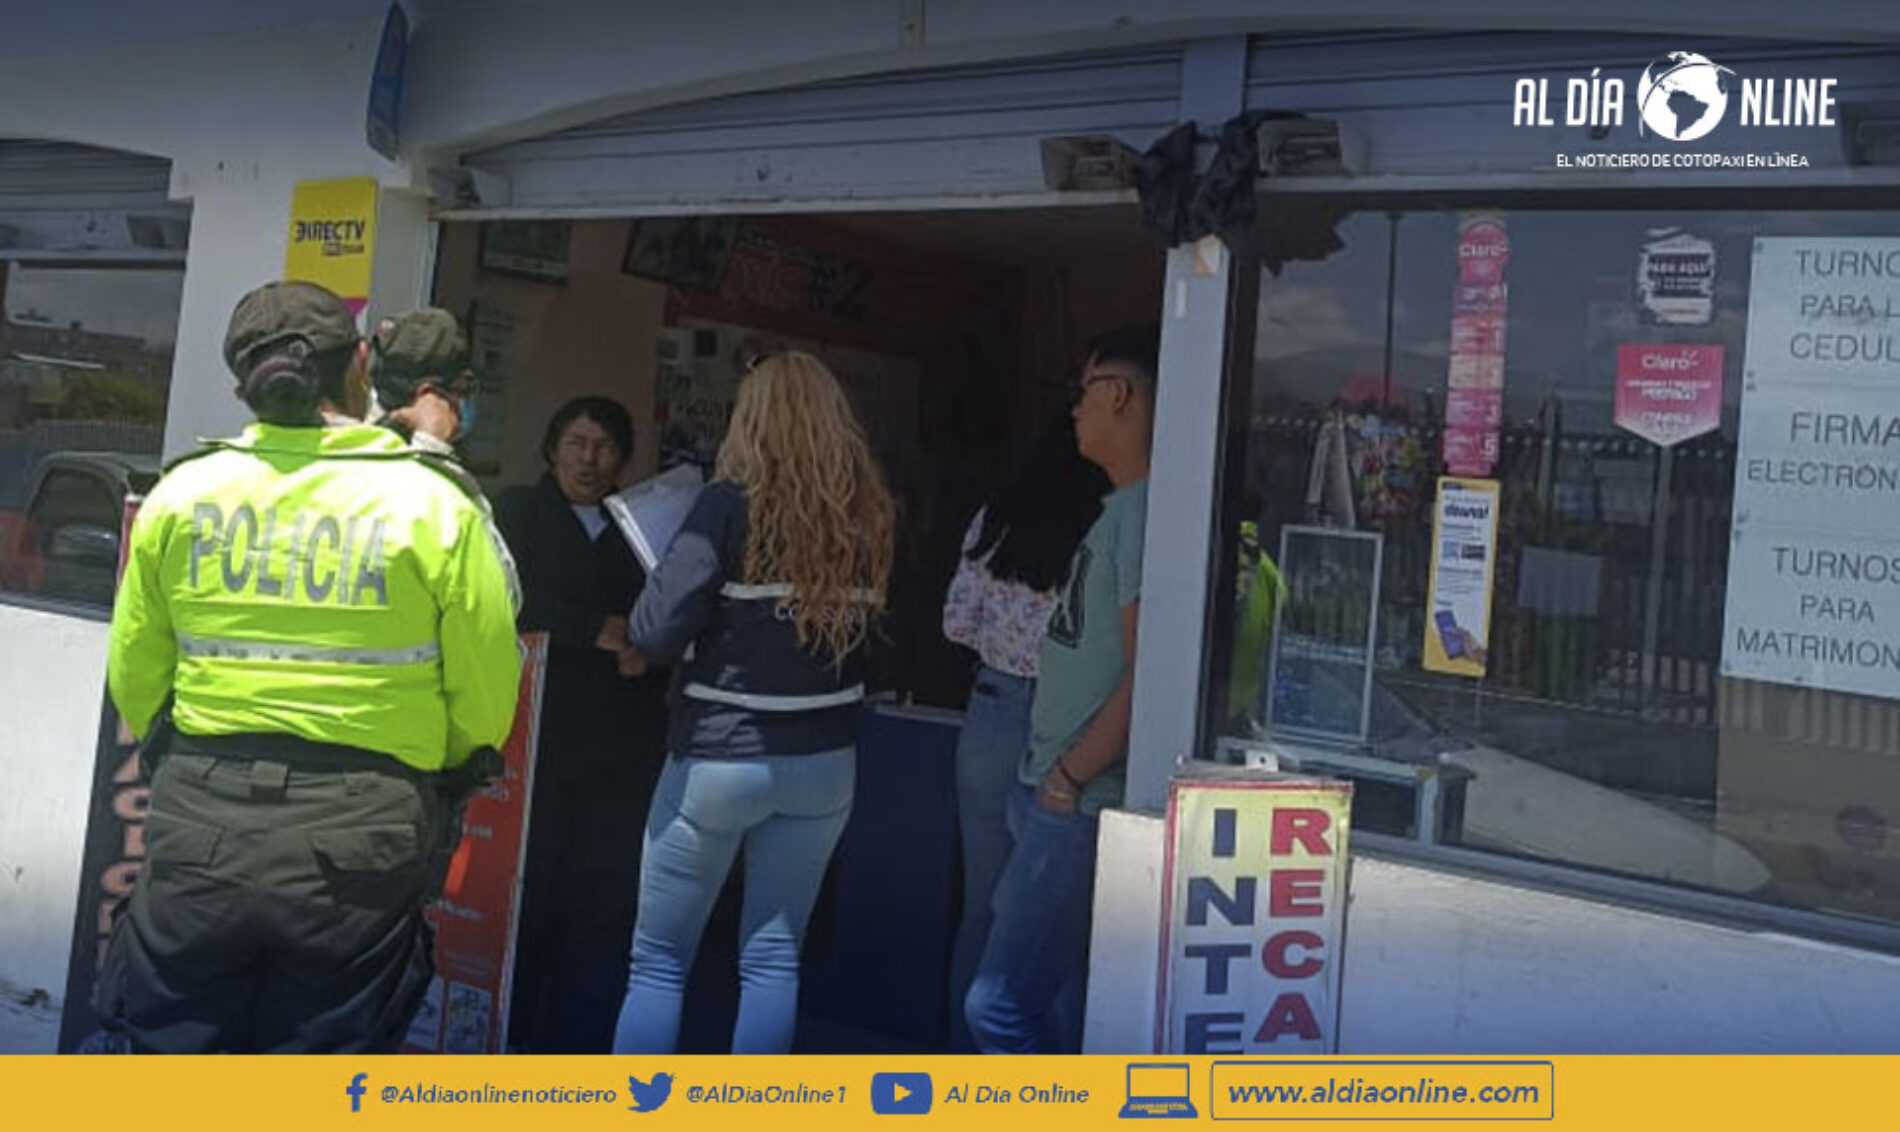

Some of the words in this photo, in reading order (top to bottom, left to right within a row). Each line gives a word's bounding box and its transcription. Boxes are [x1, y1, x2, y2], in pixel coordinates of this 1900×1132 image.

[1799, 294, 1876, 318] PARA
[1641, 354, 1690, 371] Claro
[1790, 411, 1900, 446] FIRMA
[189, 502, 389, 606] POLICIA
[1799, 595, 1875, 624] PARA
[1736, 627, 1900, 670] MATRIMON
[1253, 807, 1333, 1043] RECA
